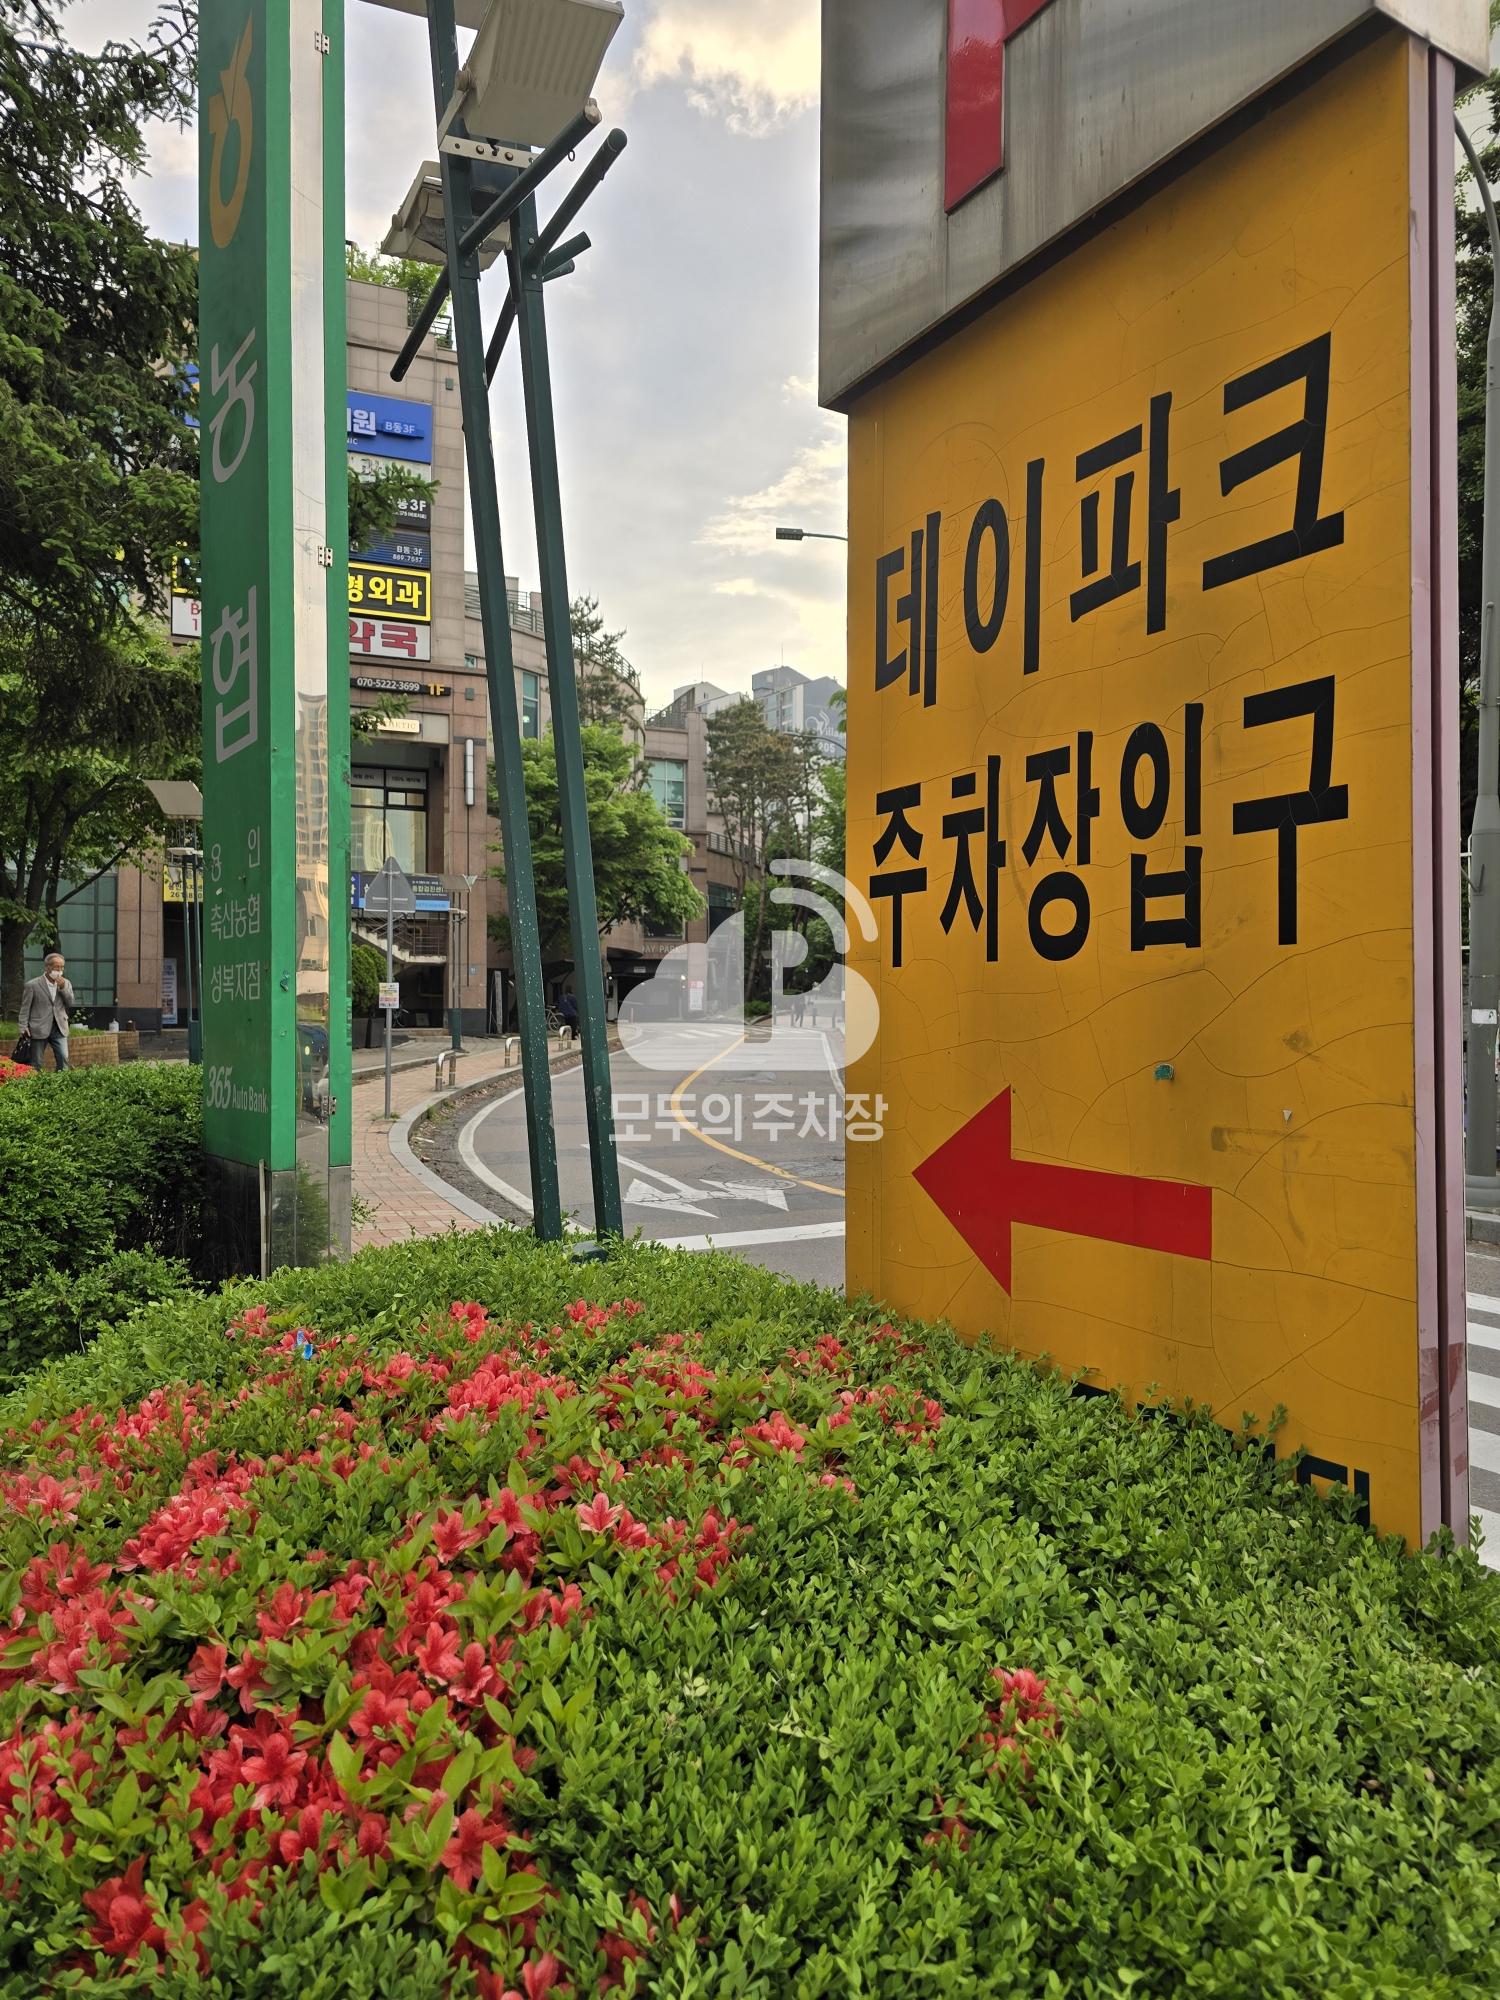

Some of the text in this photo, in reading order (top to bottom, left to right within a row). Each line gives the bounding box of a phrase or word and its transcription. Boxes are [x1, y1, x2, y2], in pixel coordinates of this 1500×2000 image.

[875, 331, 1344, 708] 데이파크
[349, 619, 418, 658] 약국
[357, 677, 445, 696] 070-5222-3699 1F
[869, 675, 1348, 968] 주차장입구
[210, 893, 261, 941] 축산농협
[210, 960, 261, 1004] 성복지점
[206, 1065, 233, 1109] 365
[232, 1084, 248, 1110] Auto
